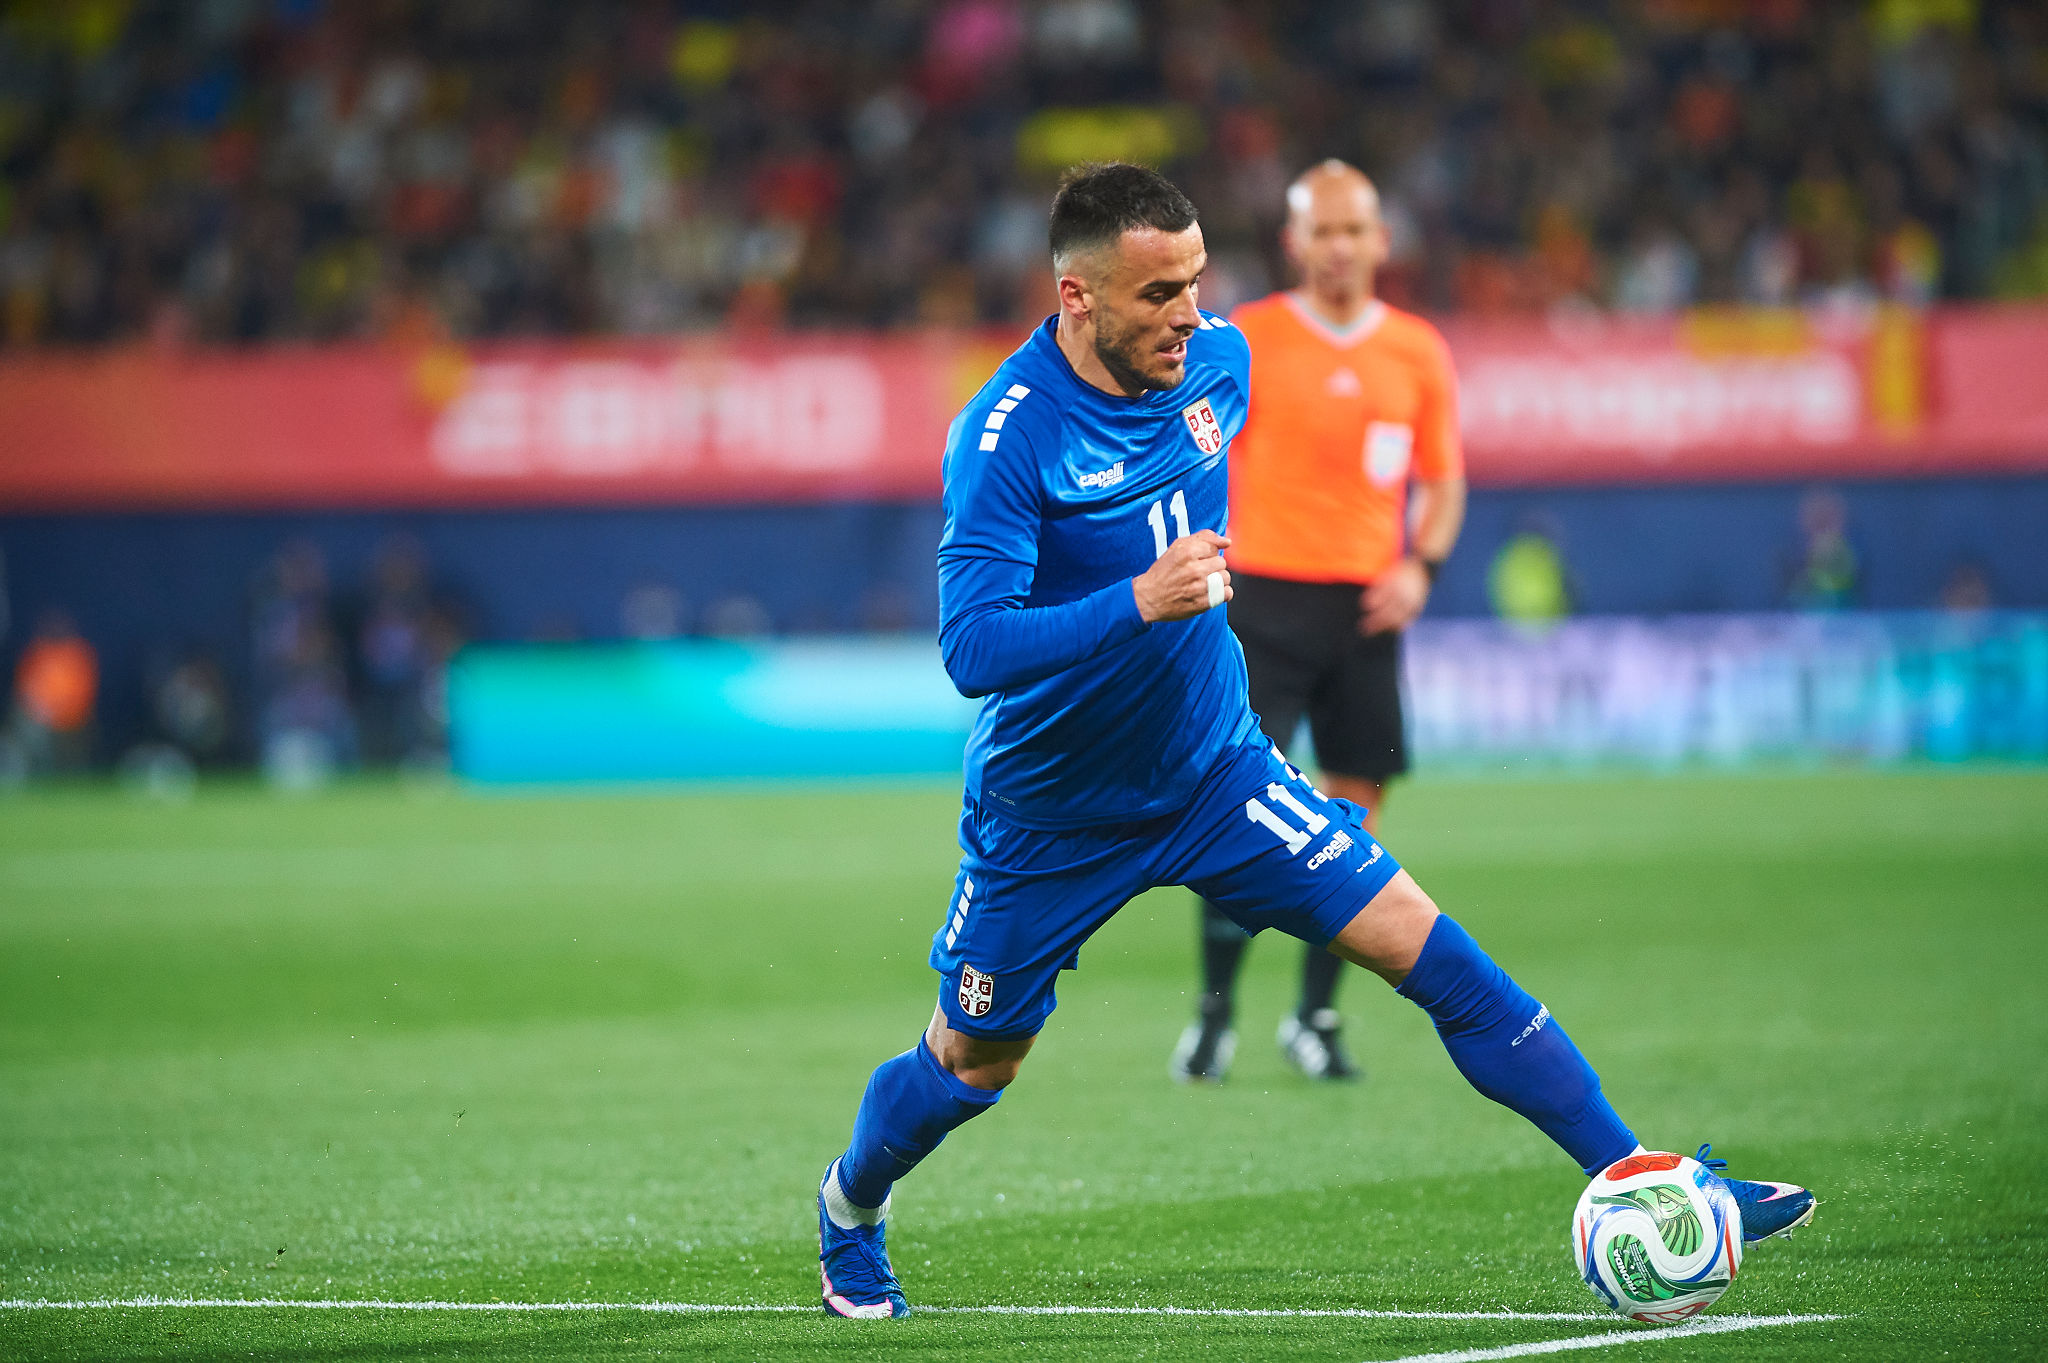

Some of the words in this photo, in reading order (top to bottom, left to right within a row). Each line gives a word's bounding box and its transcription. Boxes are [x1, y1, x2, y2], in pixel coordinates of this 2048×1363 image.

[1079, 461, 1124, 487] capelli
[1103, 475, 1124, 488] SPORT
[1148, 490, 1190, 559] 11
[1246, 782, 1330, 855] 11
[1307, 829, 1352, 870] capelli
[1333, 839, 1355, 859] SPORT
[1613, 1248, 1639, 1296] TRIONDA
